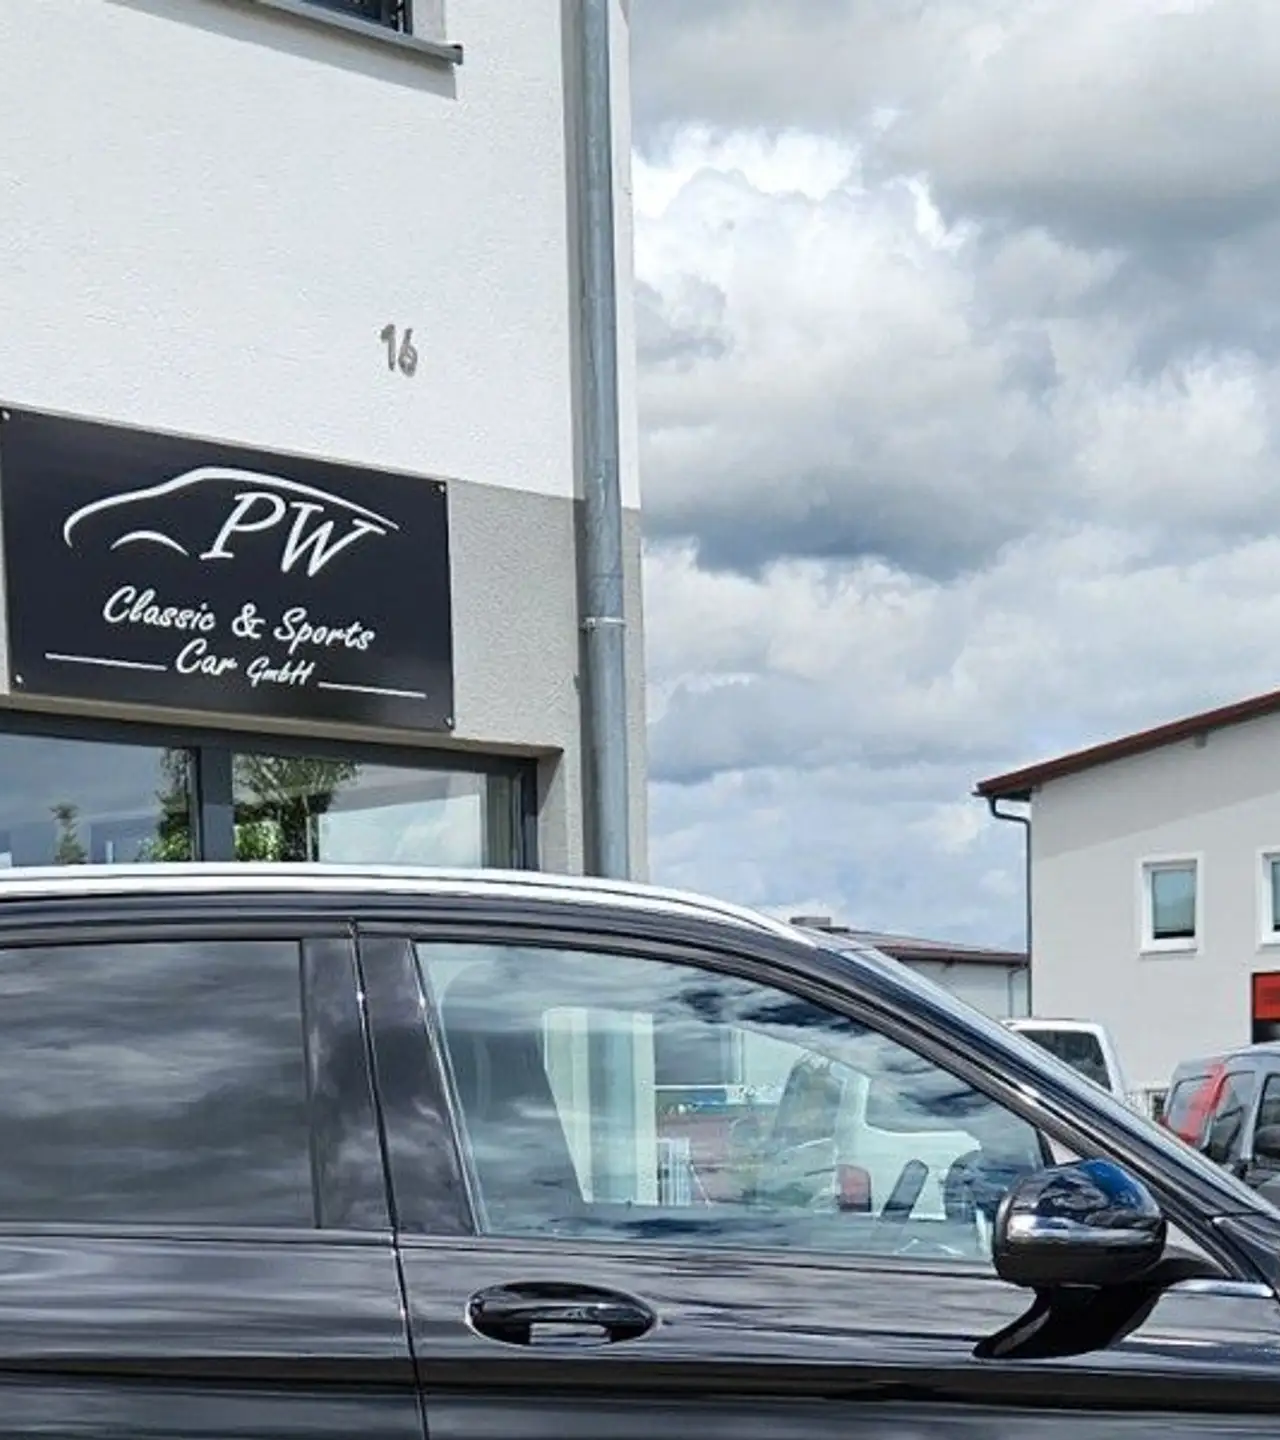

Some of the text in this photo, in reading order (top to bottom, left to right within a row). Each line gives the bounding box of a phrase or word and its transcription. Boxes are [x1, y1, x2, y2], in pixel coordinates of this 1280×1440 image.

[380, 323, 418, 377] 16
[199, 492, 387, 577] PW
[102, 585, 376, 654] Classic & Sports
[176, 638, 316, 687] Car GmbH
